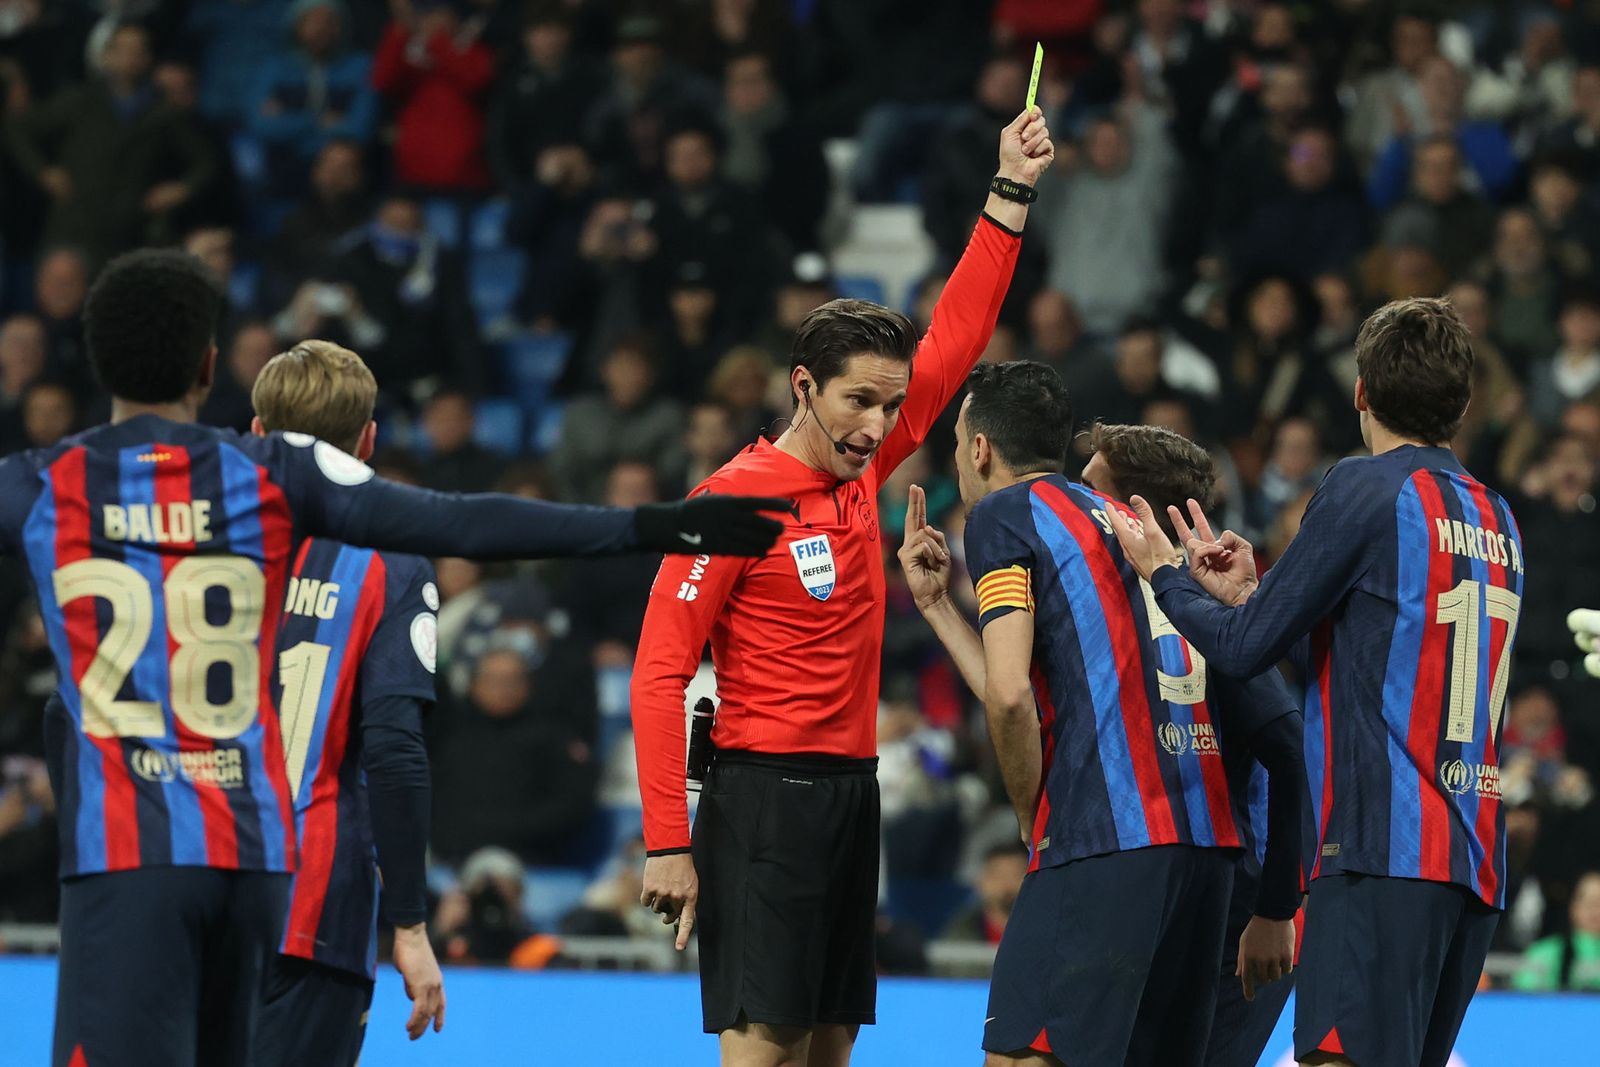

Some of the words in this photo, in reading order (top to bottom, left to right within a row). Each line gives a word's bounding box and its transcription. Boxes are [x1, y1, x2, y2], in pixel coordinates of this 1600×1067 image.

[103, 499, 213, 542] BALDE
[796, 540, 828, 559] FIFA
[1435, 518, 1509, 567] MARCOS
[802, 563, 833, 578] REFEREE
[815, 585, 830, 596] 2023
[52, 555, 266, 739] 28
[1436, 579, 1521, 746] 17
[1475, 777, 1502, 794] ACN
